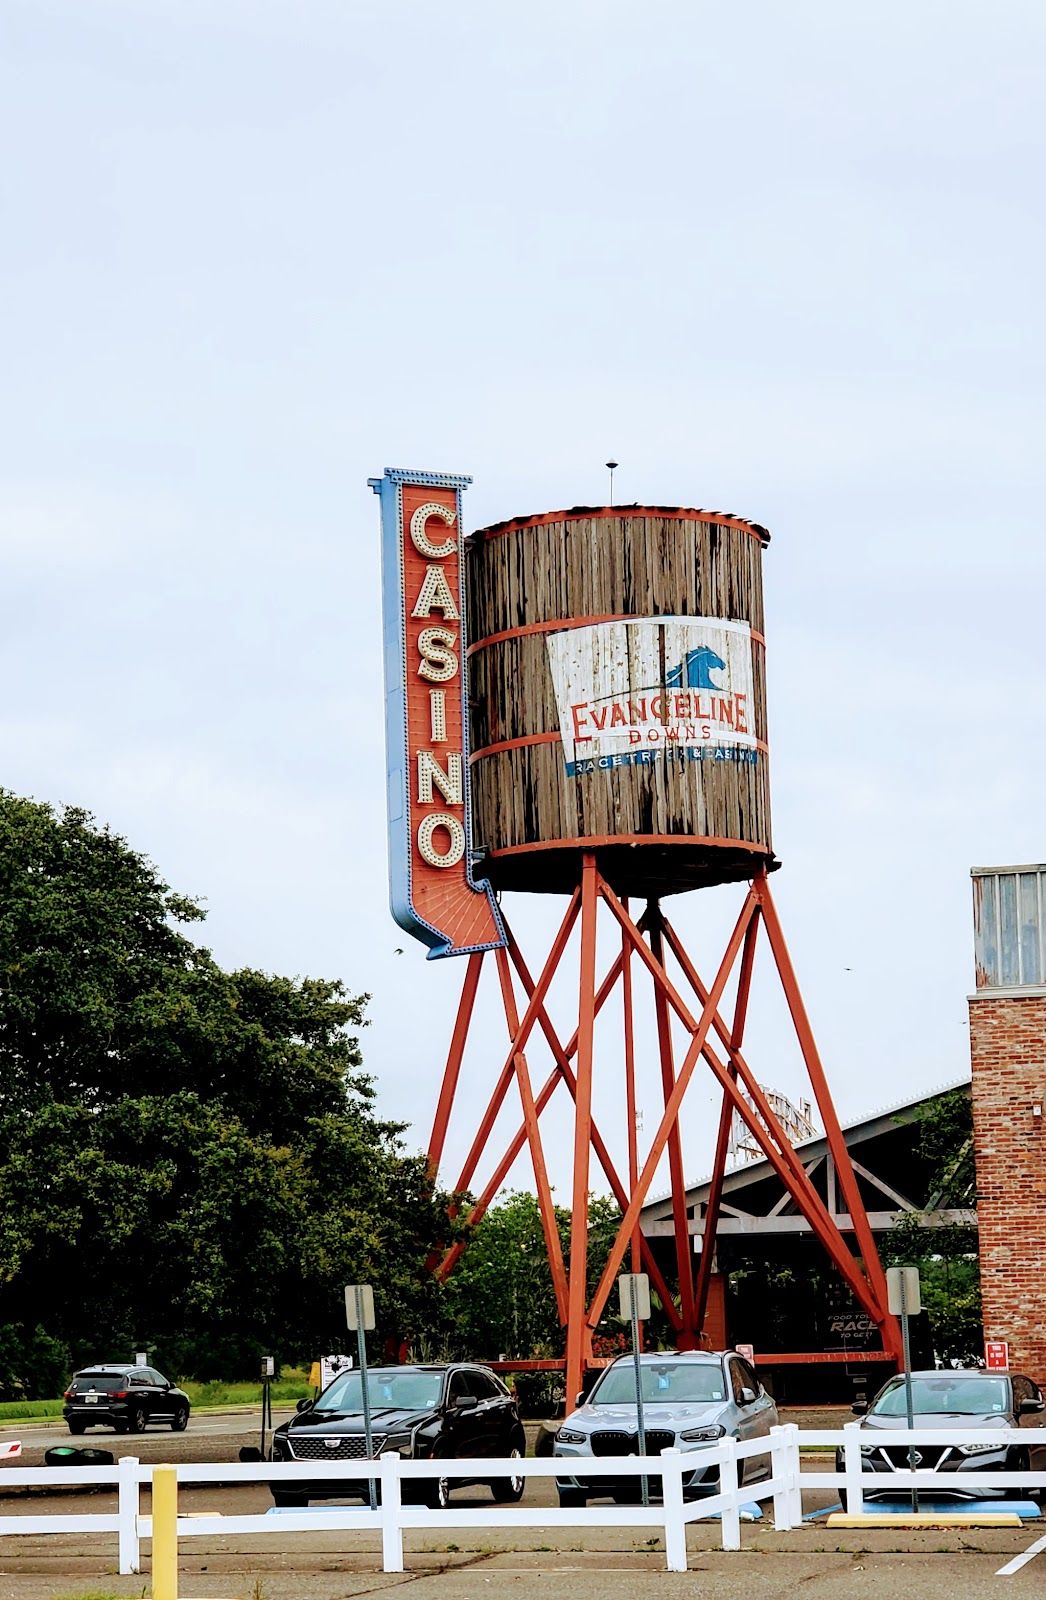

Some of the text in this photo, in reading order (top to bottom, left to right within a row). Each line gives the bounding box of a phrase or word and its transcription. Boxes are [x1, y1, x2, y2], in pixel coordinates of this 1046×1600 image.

[410, 502, 466, 868] CASINO
[570, 692, 749, 744] EVANGELINE
[629, 725, 711, 745] DOWNS
[575, 750, 684, 773] RACETRAC
[830, 1320, 879, 1332] RACE
